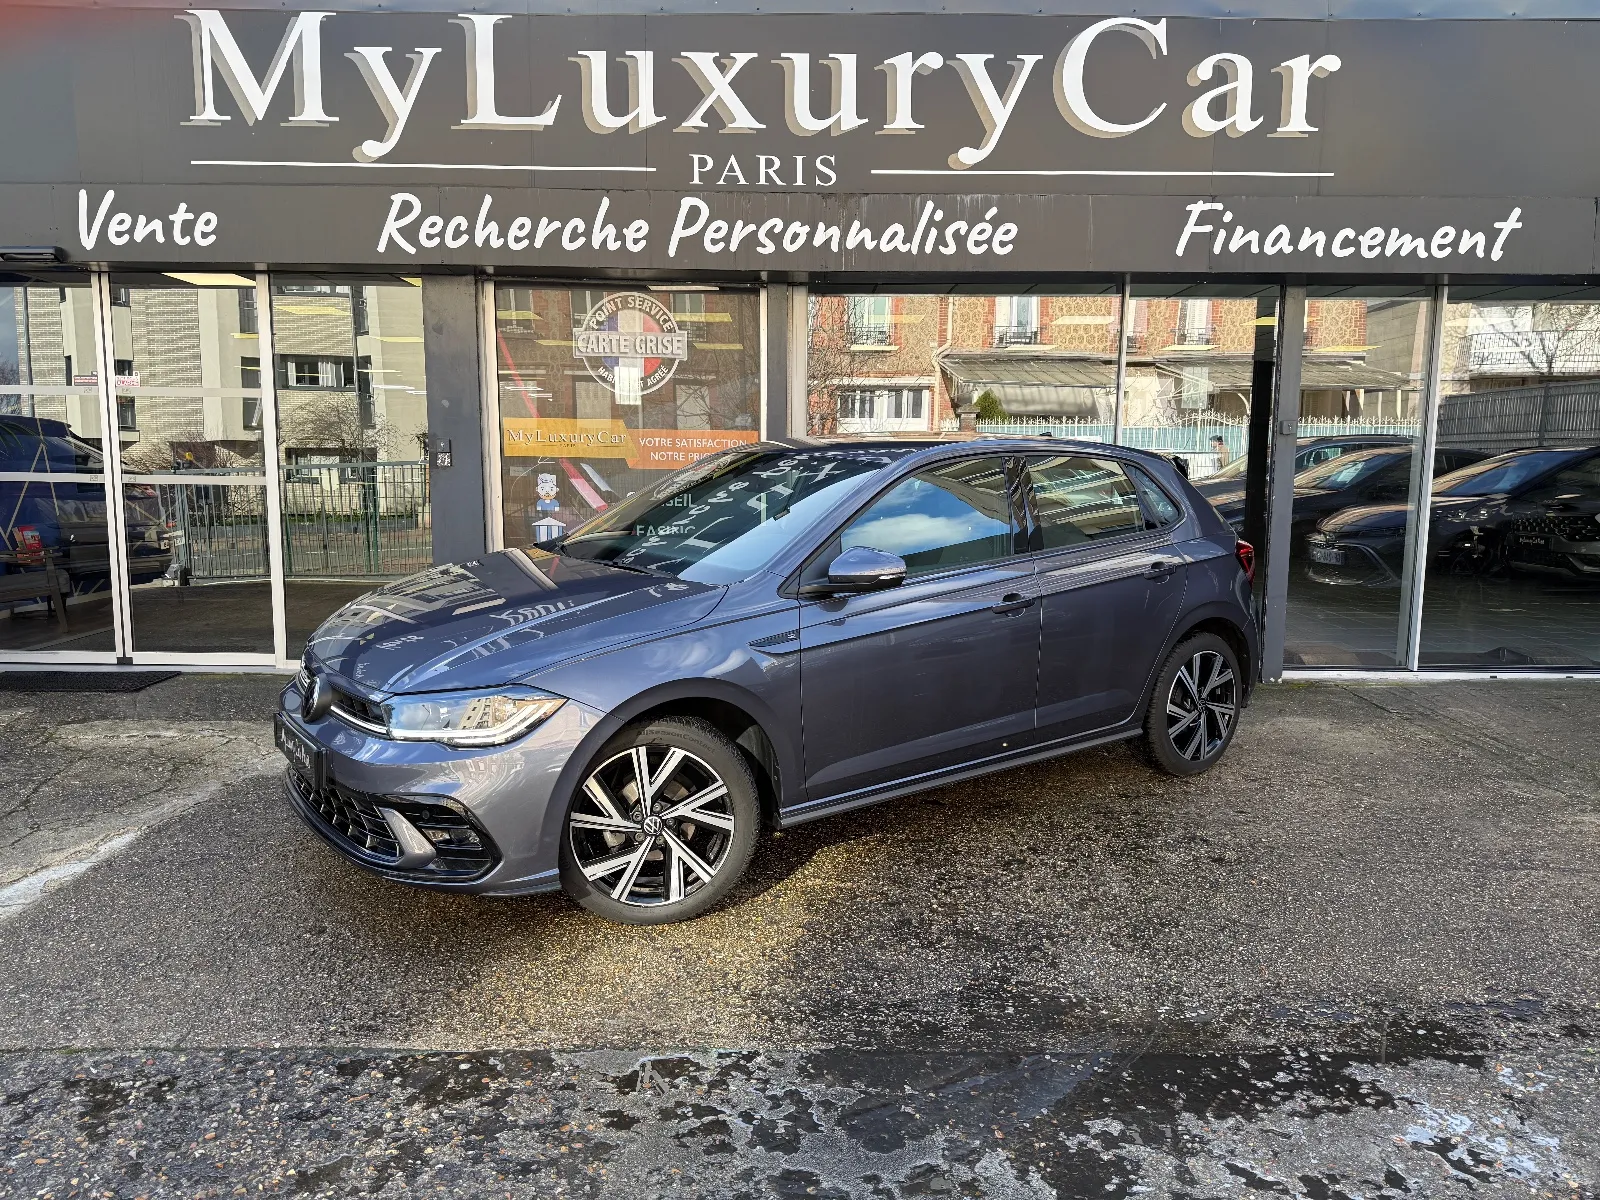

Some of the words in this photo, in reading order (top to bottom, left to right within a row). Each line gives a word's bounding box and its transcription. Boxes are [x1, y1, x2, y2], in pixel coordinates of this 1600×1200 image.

[178, 9, 1342, 165] MyLuxuryCar
[689, 153, 838, 187] PARIS
[78, 188, 219, 251] Vente
[377, 192, 649, 255] Recherche
[667, 197, 1019, 258] Personnalisée
[1175, 200, 1523, 262] Financement
[589, 298, 623, 330] POINT
[627, 296, 674, 332] SERVICE
[577, 334, 630, 353] CARTE
[635, 335, 683, 355] GRISE
[507, 429, 627, 446] MyLuxuryCar
[639, 437, 673, 447] VOTRE
[675, 438, 747, 448] SATISFACTION
[650, 451, 686, 461] NOTRE
